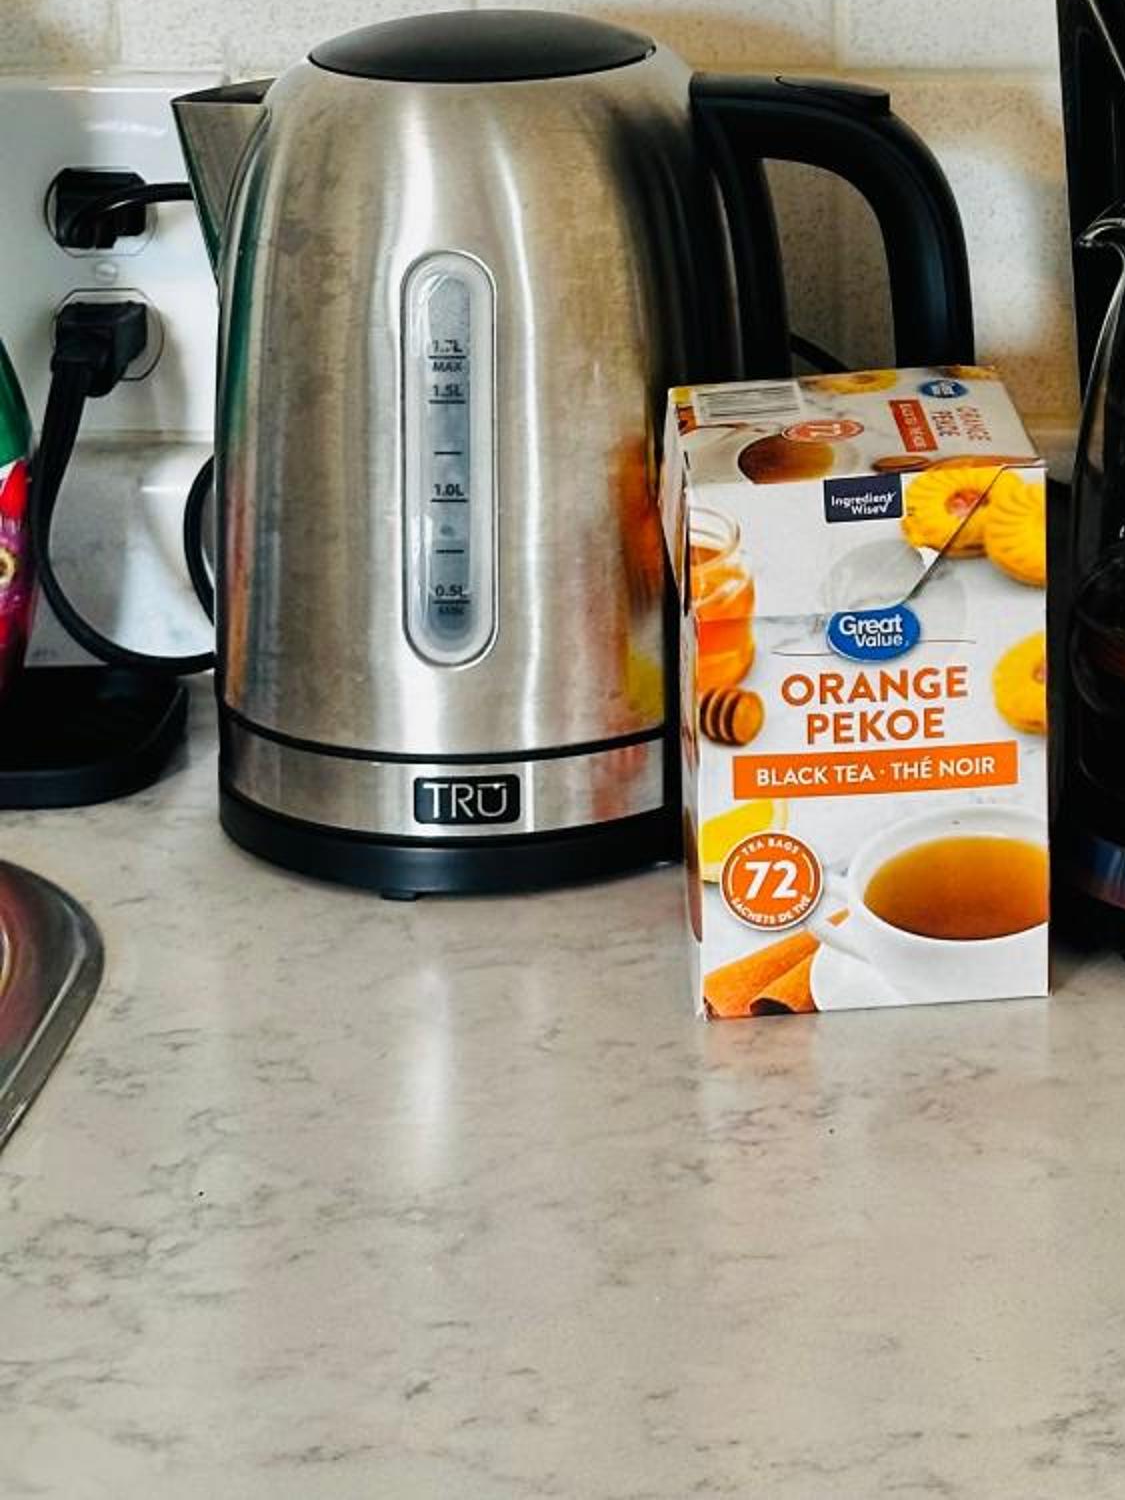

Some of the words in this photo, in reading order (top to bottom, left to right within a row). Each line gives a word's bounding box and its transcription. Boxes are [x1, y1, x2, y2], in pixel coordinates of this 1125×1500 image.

[433, 362, 463, 373] MAX
[434, 484, 464, 497] 1.0L
[831, 490, 897, 509] Ingredient
[838, 613, 903, 636] Great
[855, 633, 903, 648] Value
[781, 665, 969, 707] ORANGE
[806, 707, 946, 745] PEKOE
[756, 766, 830, 787] BLACK
[833, 764, 875, 784] TEA
[890, 757, 933, 780] THÉ
[938, 756, 996, 778] NOIR
[741, 839, 765, 855] TEA
[745, 861, 799, 900] 72
